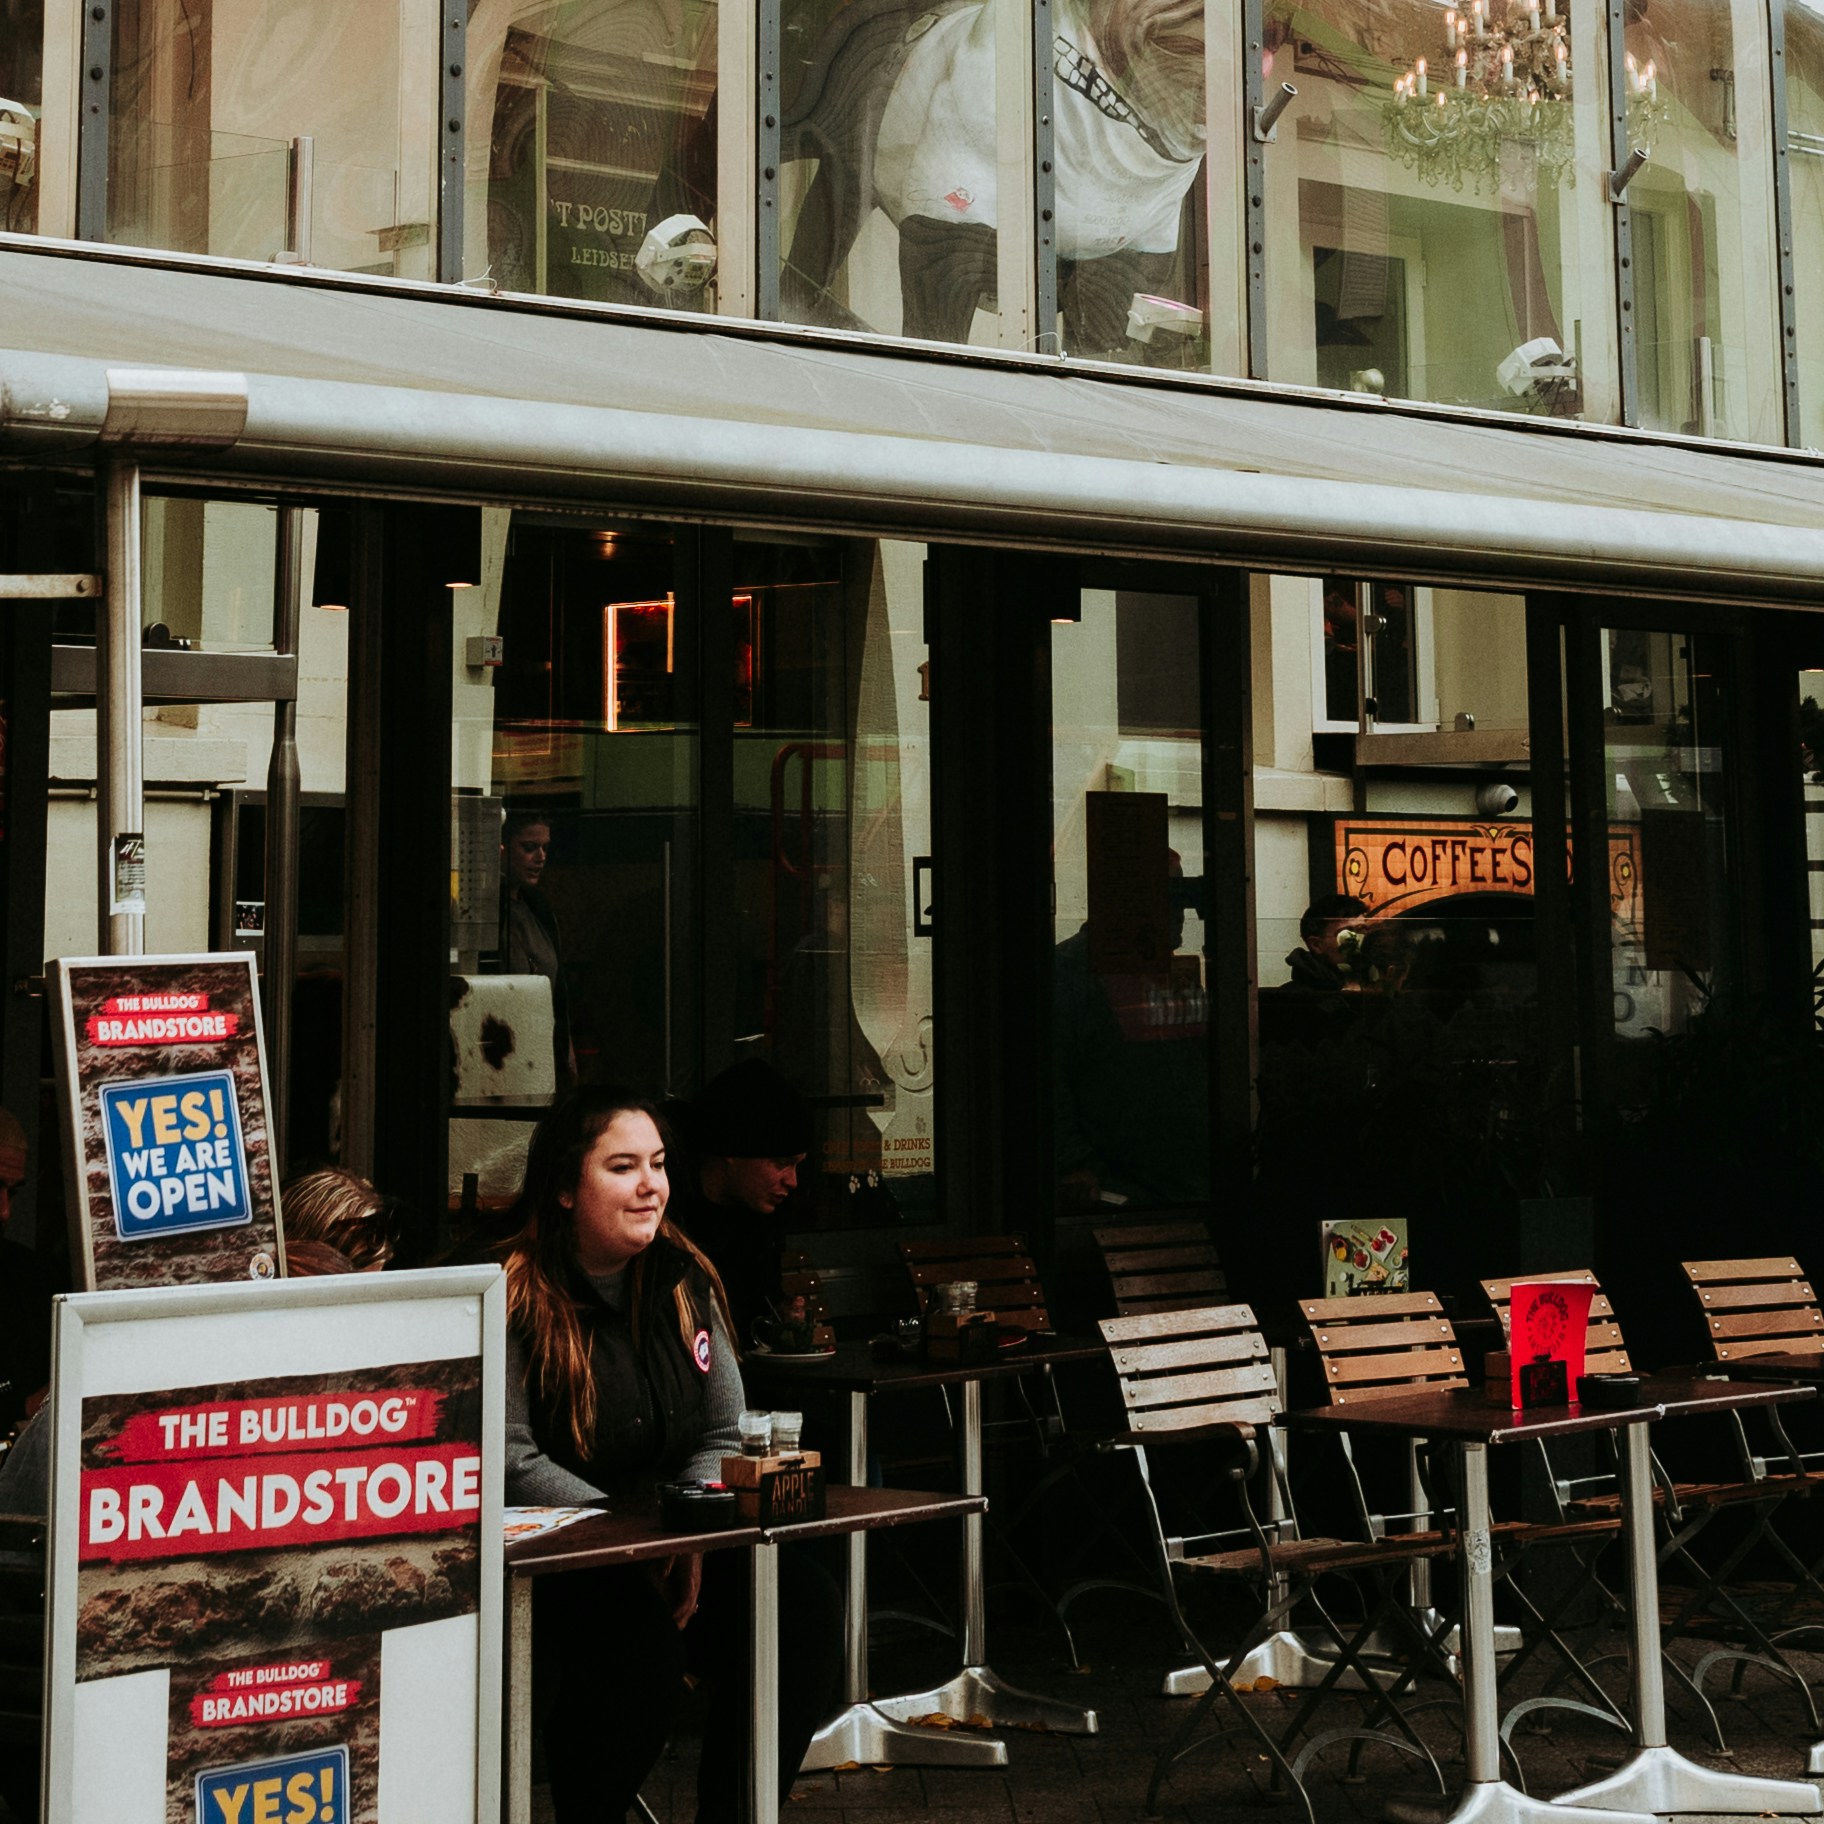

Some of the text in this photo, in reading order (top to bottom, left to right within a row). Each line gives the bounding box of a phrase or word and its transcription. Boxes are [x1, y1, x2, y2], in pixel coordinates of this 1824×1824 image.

[115, 996, 140, 1012] THE
[96, 1015, 227, 1042] BRANDSTORE
[115, 1088, 229, 1149] YES!
[121, 1138, 233, 1180] WE ARE
[889, 1156, 932, 1170] BULLDOG
[894, 1137, 932, 1151] DRINKS
[126, 1168, 237, 1221] OPEN
[158, 1408, 229, 1451] THE
[87, 1455, 481, 1546] BRANDSTORE
[772, 1470, 815, 1502] APPLE
[227, 1670, 254, 1688] THE
[201, 1683, 348, 1723] BRANDSTORE
[211, 1766, 336, 1824] YES!
